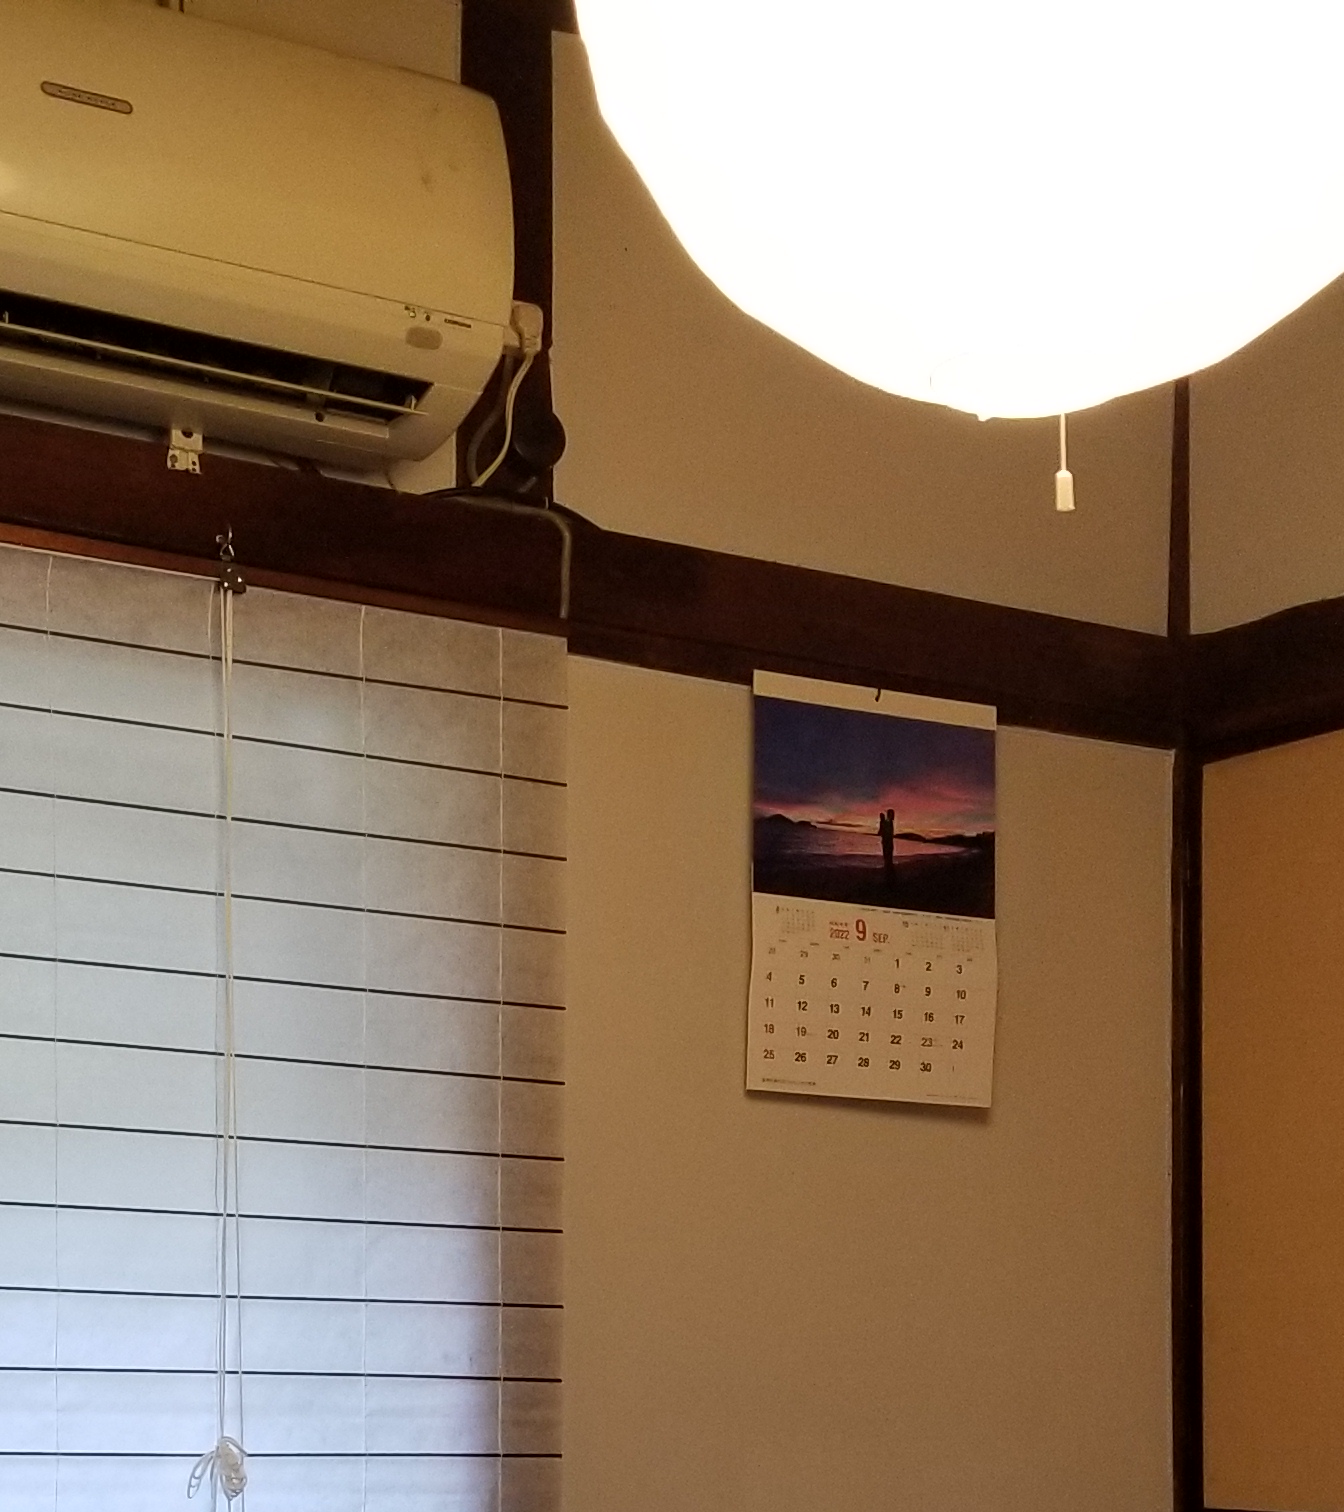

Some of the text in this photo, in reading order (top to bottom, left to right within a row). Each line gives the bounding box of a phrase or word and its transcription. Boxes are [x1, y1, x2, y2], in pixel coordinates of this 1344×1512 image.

[829, 928, 850, 940] 2022
[855, 918, 867, 942] 9
[872, 932, 891, 944] SEP.
[894, 958, 900, 969] 1
[925, 961, 933, 972] 2
[955, 964, 963, 975] 3
[765, 971, 967, 1000] 4 5 6 7 8 9 10
[764, 997, 966, 1025] 11 12 13 14 15 16 17
[763, 1023, 964, 1050] 18 19 20 21 22 23 24
[763, 1048, 775, 1060] 25
[794, 1051, 807, 1063] 26
[826, 1054, 839, 1065] 27
[857, 1056, 870, 1068] 28
[888, 1059, 901, 1071] 29
[919, 1061, 932, 1073] 30
